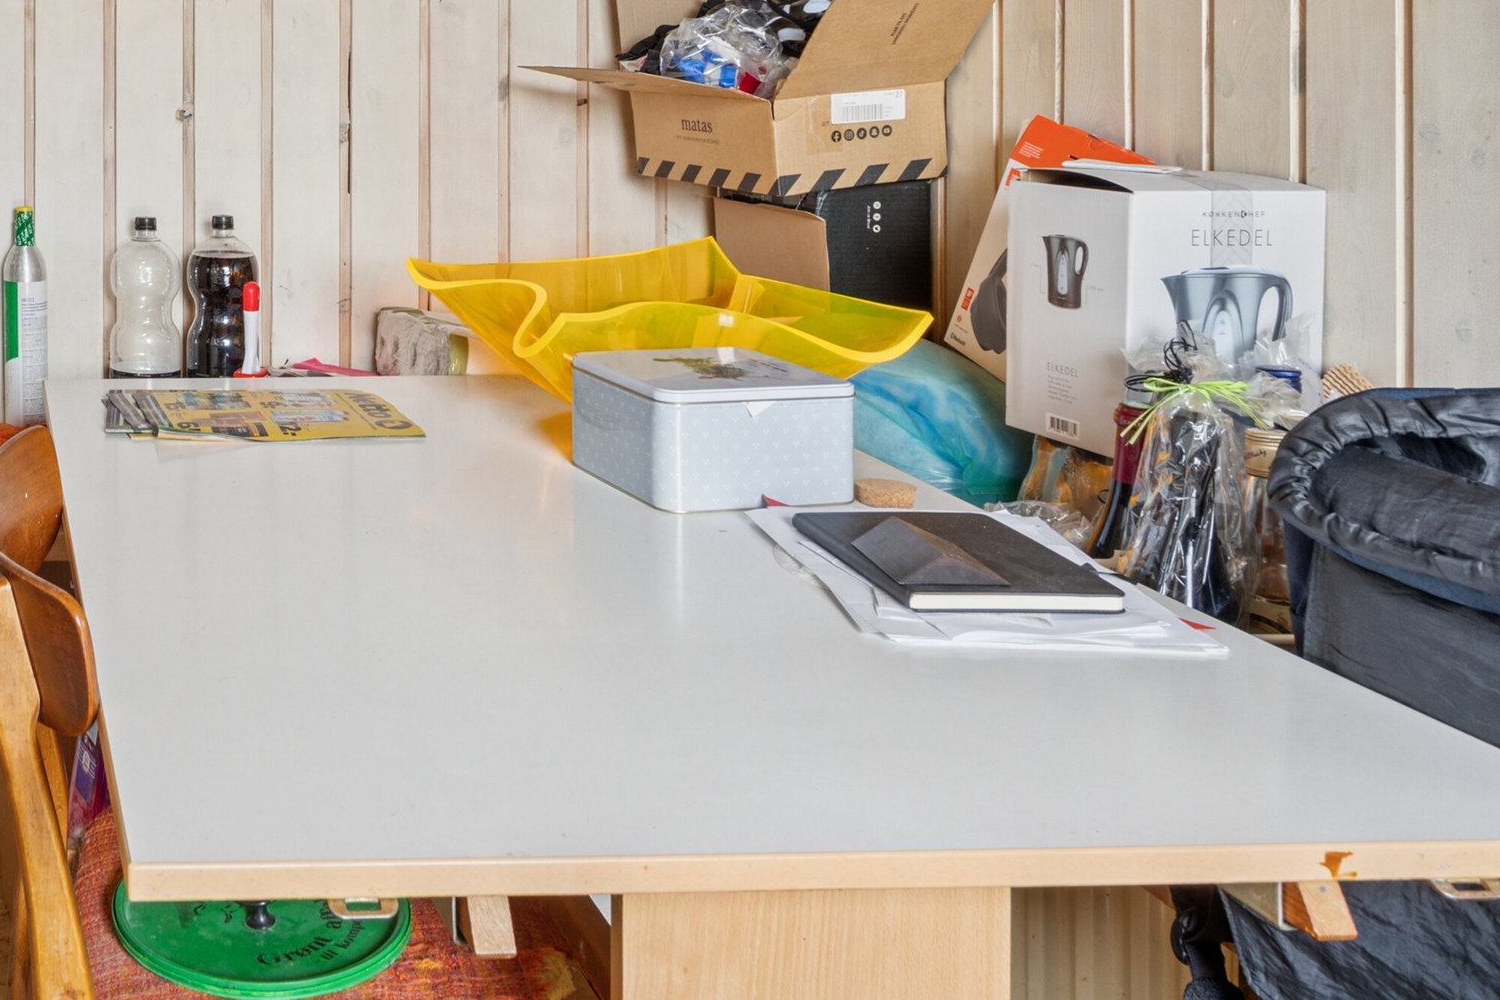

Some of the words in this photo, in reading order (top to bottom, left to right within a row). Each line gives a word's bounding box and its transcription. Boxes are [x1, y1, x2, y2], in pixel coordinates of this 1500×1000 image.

[681, 119, 713, 134] matas
[1191, 229, 1274, 247] ELKEDEL
[1046, 362, 1079, 379] ELKEDEL
[344, 392, 393, 419] Netto
[257, 935, 333, 966] Grønt
